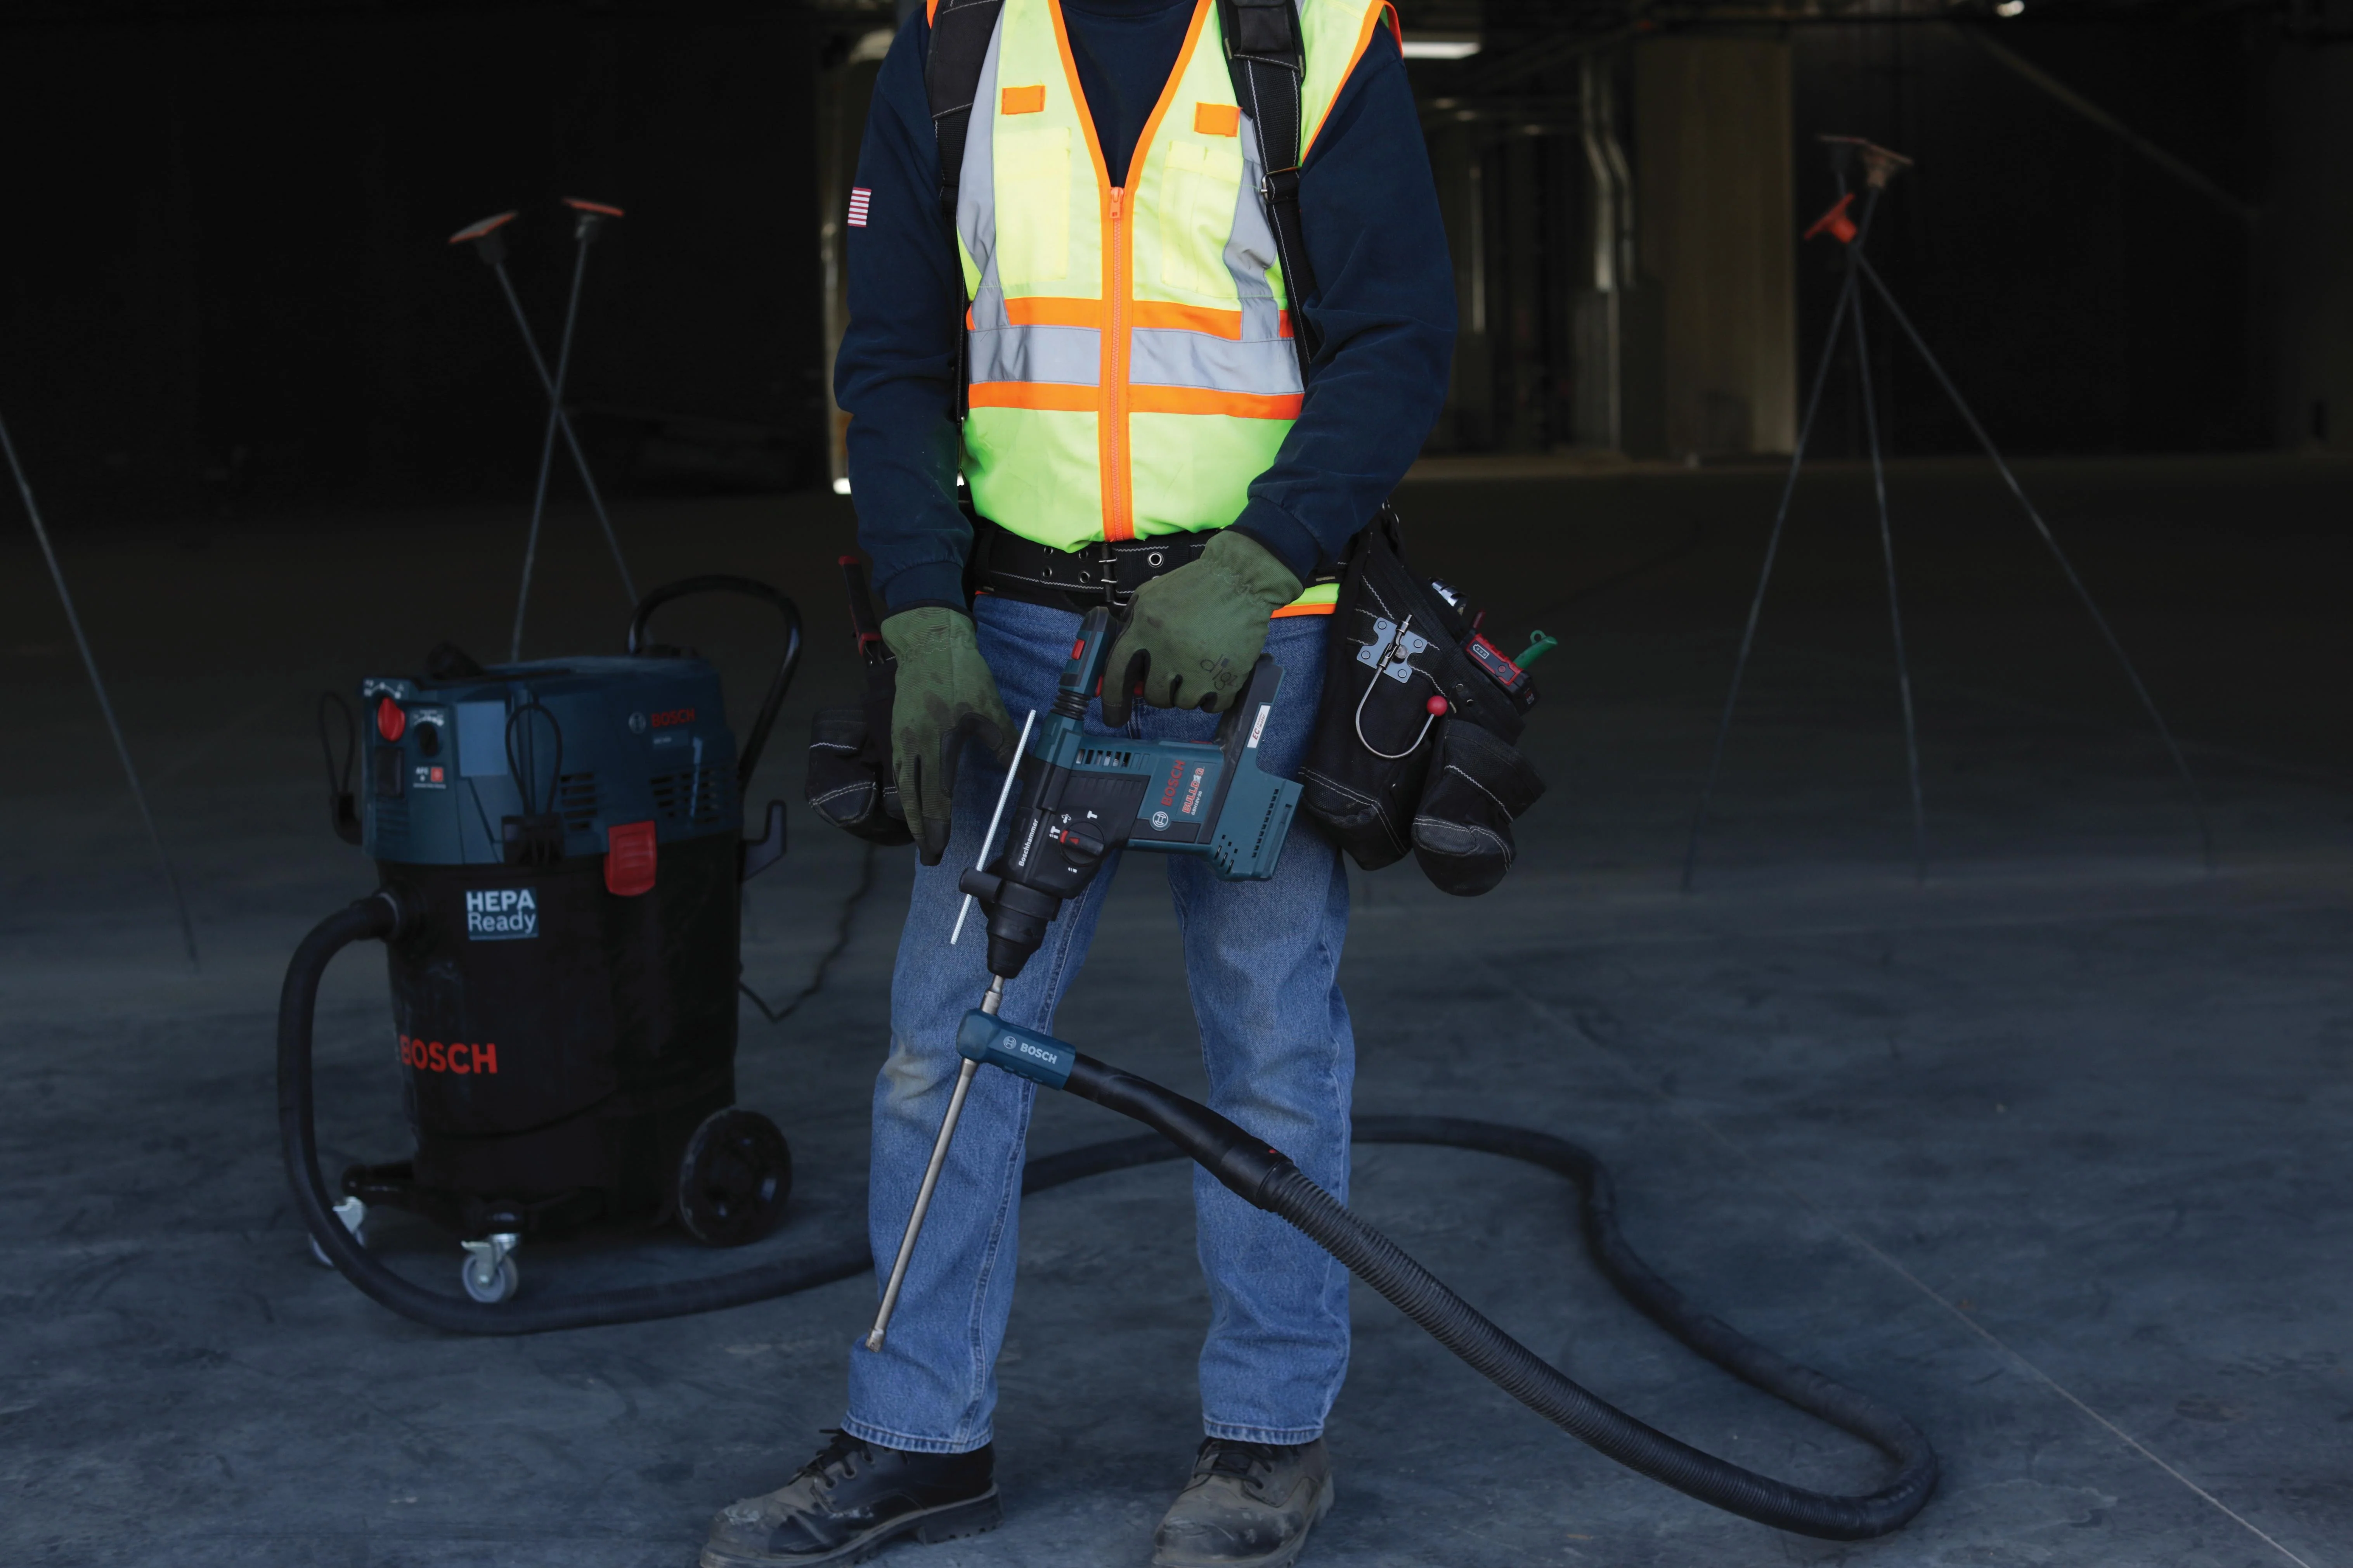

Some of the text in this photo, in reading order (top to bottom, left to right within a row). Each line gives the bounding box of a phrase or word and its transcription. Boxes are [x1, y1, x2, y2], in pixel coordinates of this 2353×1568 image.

[651, 708, 695, 729] BOSCH
[1252, 728, 1260, 740] EC
[1161, 759, 1186, 807] BOSCH
[1018, 818, 1039, 867] Boschhammer
[466, 888, 535, 912] HEPA
[467, 909, 536, 934] Ready
[399, 1033, 498, 1075] BOSCH
[1020, 1042, 1058, 1065] BOSCH
